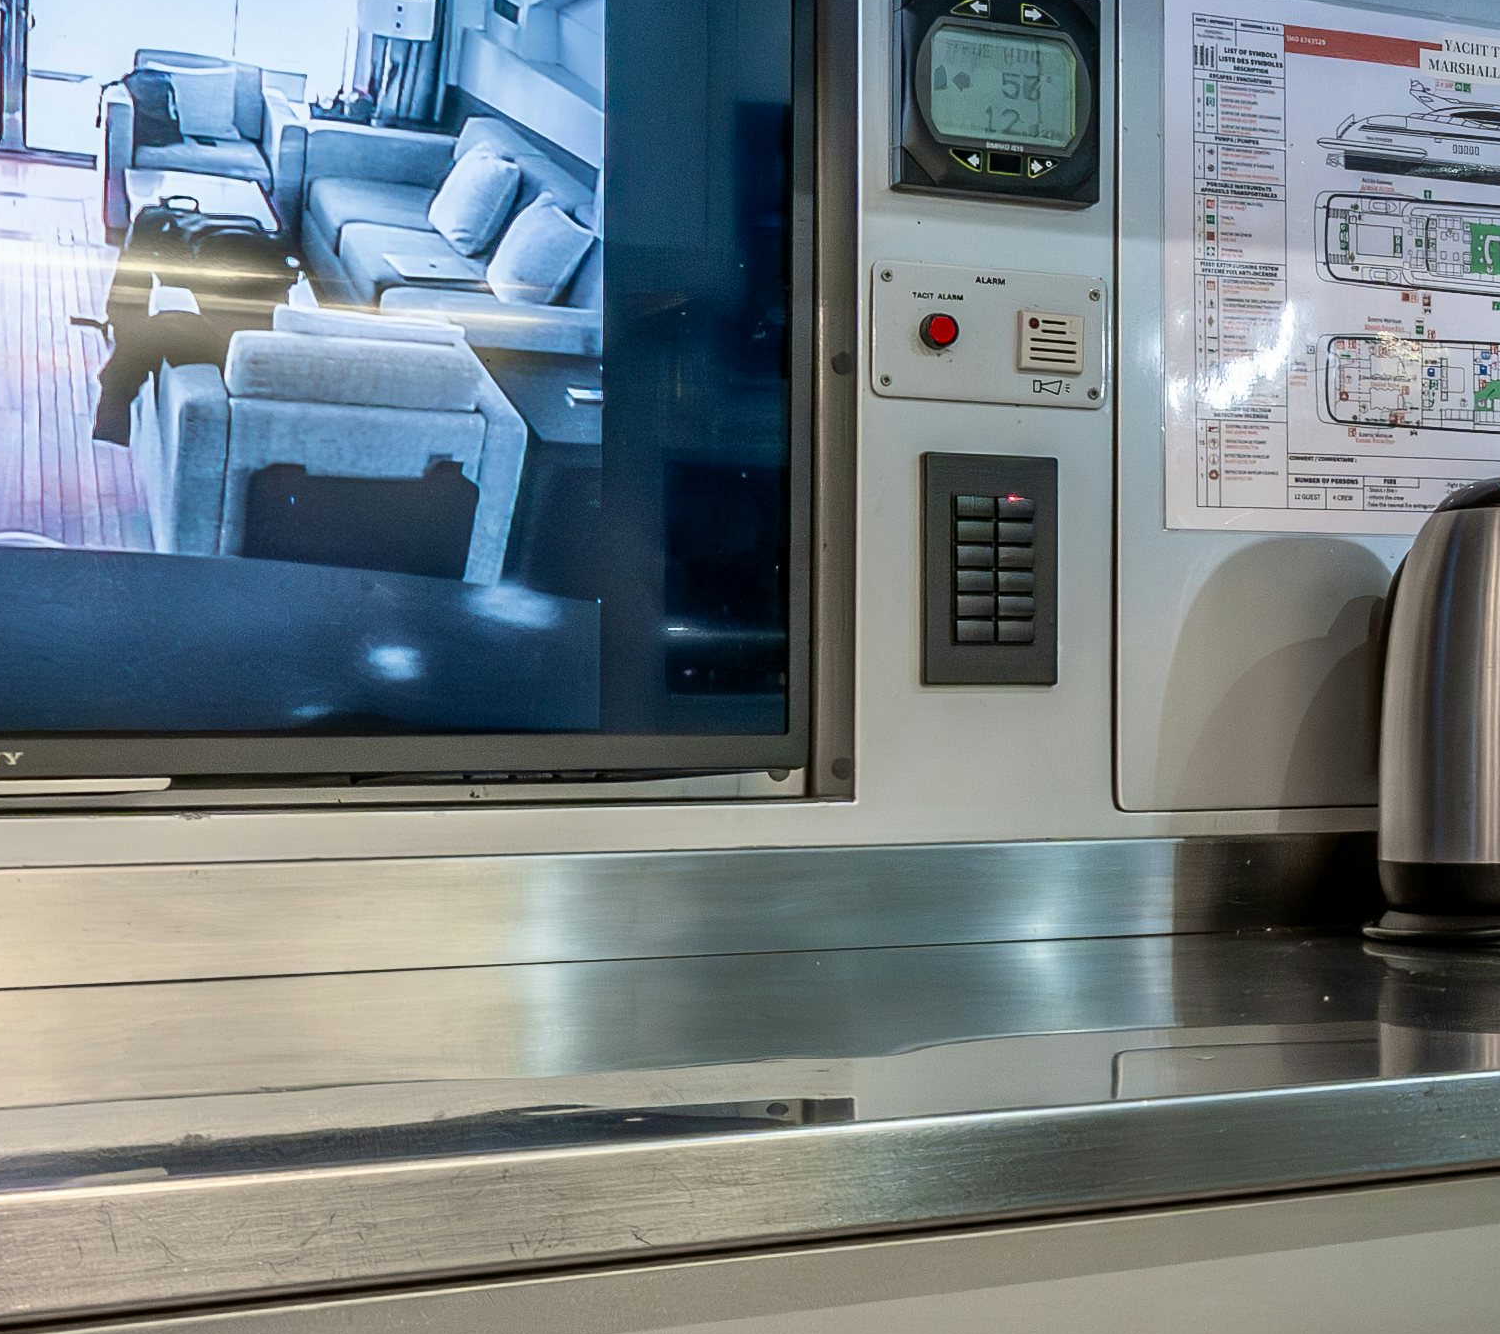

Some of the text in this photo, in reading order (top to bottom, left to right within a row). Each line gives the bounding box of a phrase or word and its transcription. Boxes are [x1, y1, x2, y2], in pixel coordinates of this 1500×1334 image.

[1444, 39, 1489, 56] YACHT
[1428, 58, 1500, 79] MARSHALL
[975, 276, 1006, 286] ALARM
[912, 291, 964, 301] TACIT ALARM
